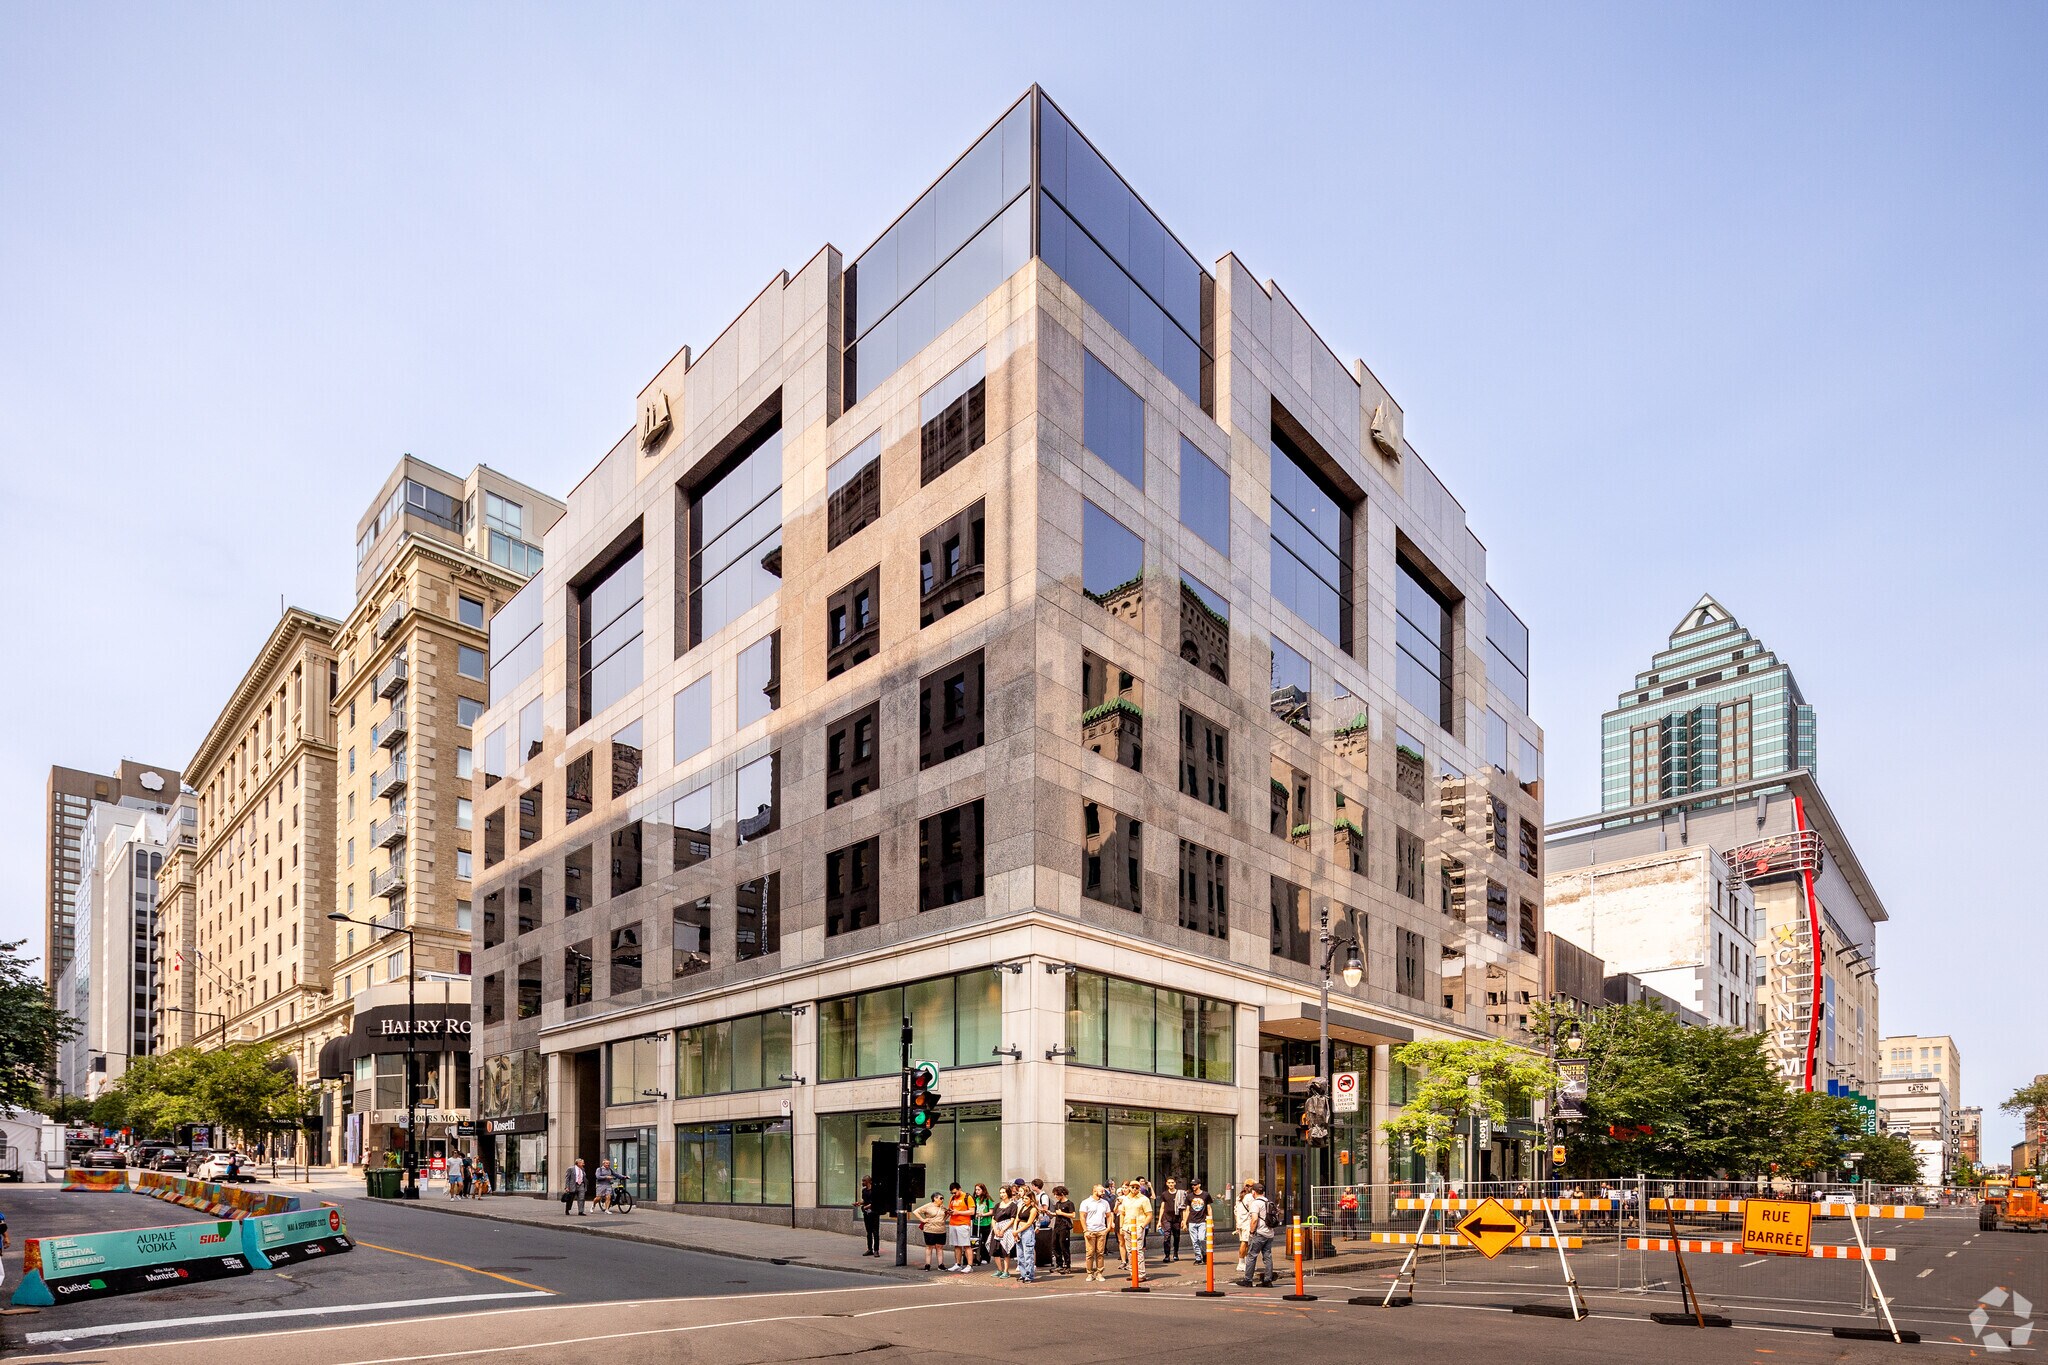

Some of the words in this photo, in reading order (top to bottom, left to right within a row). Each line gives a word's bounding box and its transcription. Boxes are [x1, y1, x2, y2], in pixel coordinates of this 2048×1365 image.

[1775, 946, 1801, 1092] CINÉM
[381, 1019, 442, 1034] HARRY
[493, 1117, 515, 1132] Rosetti
[1492, 1121, 1507, 1133] Roots
[1867, 1109, 1875, 1136] mons
[66, 1131, 89, 1139] edEx
[1479, 1119, 1488, 1148] Roots
[1951, 1110, 1959, 1153] EATON
[1762, 1210, 1790, 1223] RUE
[55, 1238, 78, 1248] PEEL
[137, 1231, 176, 1244] AUPALE
[1747, 1230, 1804, 1246] BARRÉE
[57, 1247, 96, 1258] FESTIVAL
[137, 1242, 177, 1254] VODKA
[58, 1255, 105, 1269] GOURMAND
[145, 1270, 180, 1282] Montréal
[57, 1282, 93, 1294] Québec
